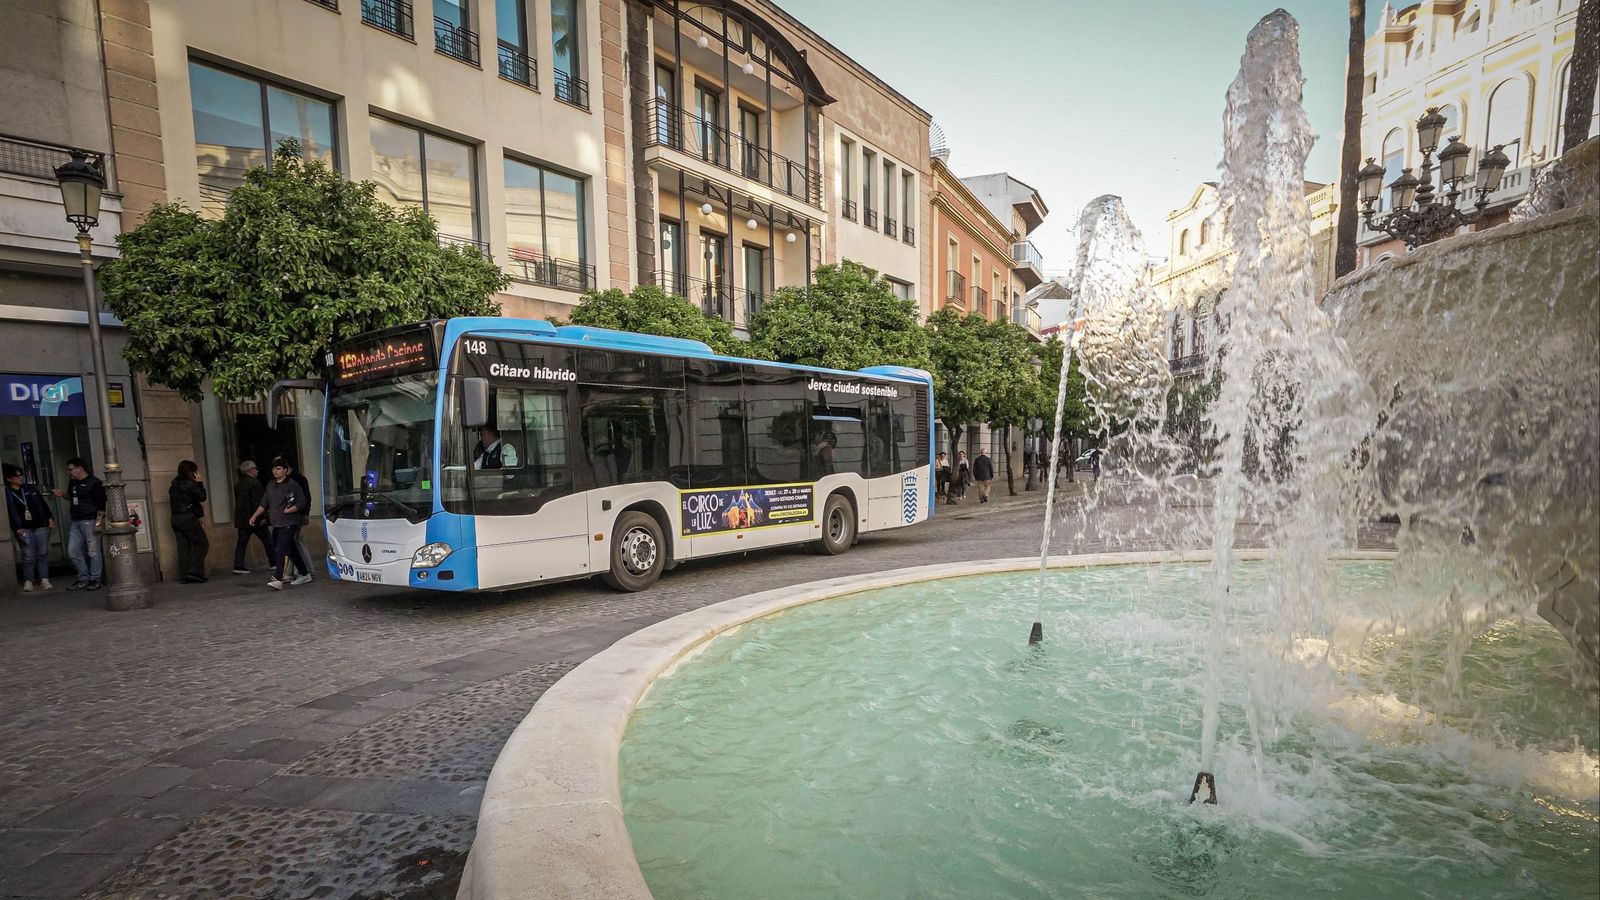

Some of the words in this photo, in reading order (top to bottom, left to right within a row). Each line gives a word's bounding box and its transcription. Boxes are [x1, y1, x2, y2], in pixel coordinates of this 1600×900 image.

[464, 340, 487, 354] 148
[489, 363, 531, 378] Citaro
[533, 366, 577, 381] híbrido
[10, 383, 69, 402] DIGI
[808, 378, 832, 392] Jerez
[833, 381, 860, 394] ciudad
[861, 384, 898, 398] sostenible
[682, 501, 687, 510] EL
[688, 494, 719, 513] CIRCO
[697, 512, 712, 530] LUZ
